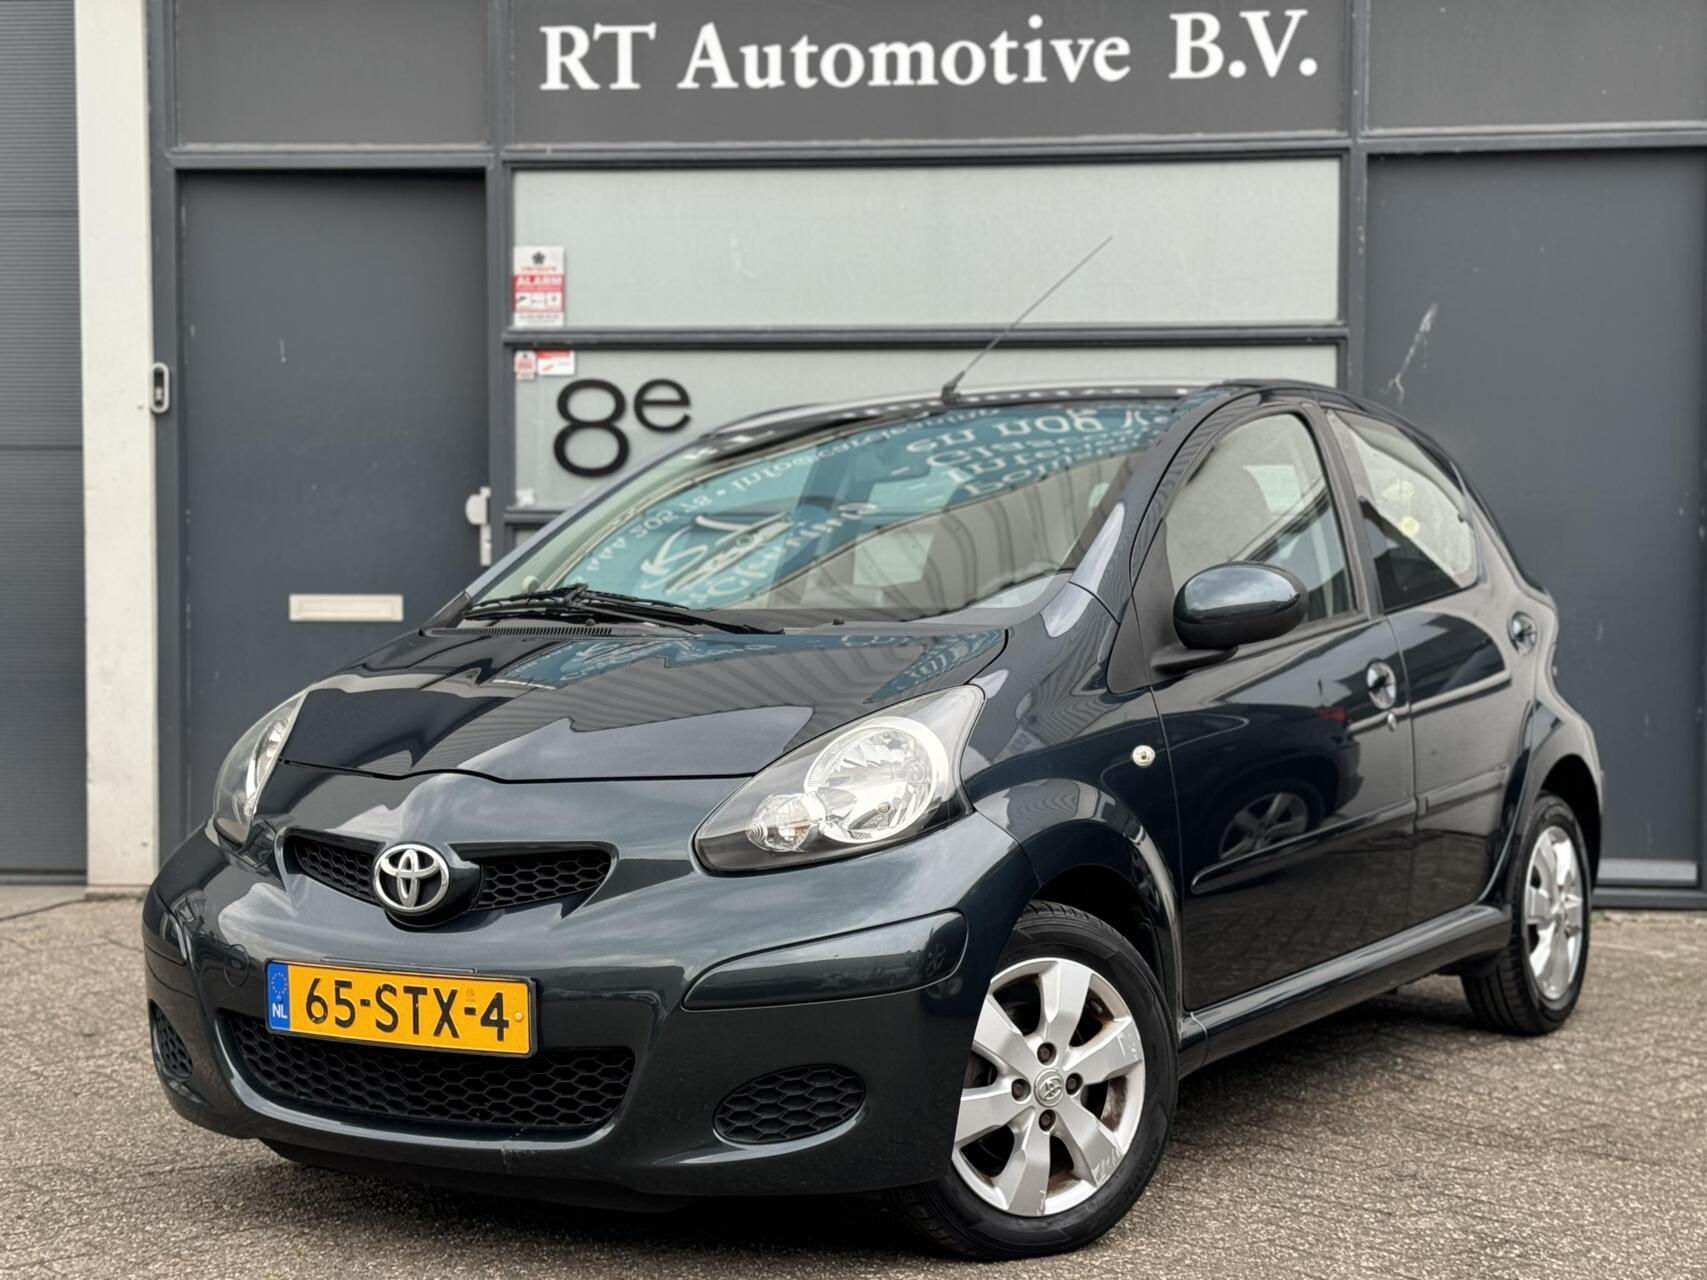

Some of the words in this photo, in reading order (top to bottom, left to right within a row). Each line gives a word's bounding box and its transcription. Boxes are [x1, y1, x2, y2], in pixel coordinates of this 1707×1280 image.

[540, 22, 657, 91] RT
[677, 14, 1131, 91] Automotive
[1168, 8, 1318, 80] B.V.
[271, 1002, 289, 1020] NL
[305, 977, 510, 1042] 65-STX-4
